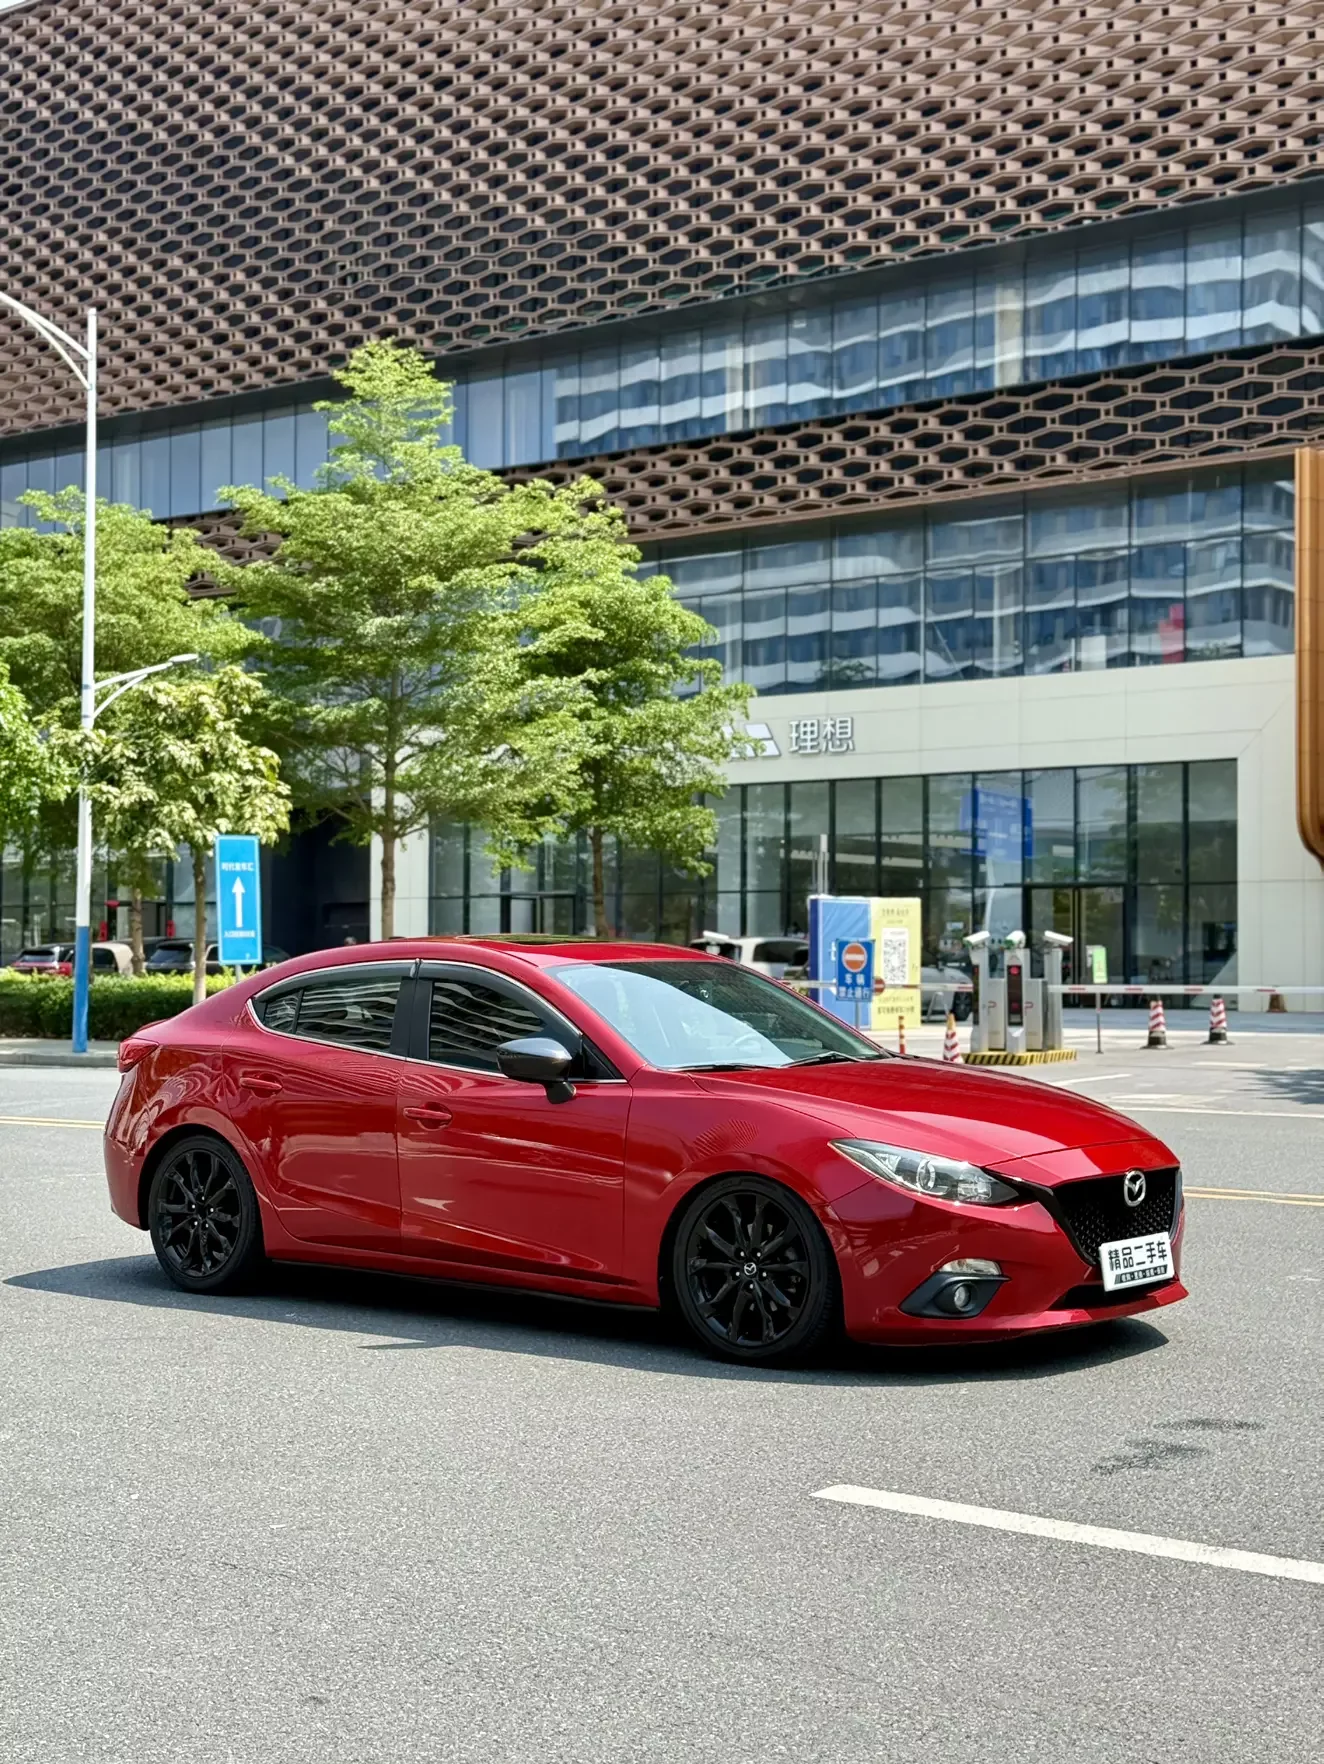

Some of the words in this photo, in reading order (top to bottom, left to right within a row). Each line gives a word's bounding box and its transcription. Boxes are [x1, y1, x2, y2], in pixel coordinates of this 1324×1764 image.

[788, 717, 855, 754] 理想
[1108, 1240, 1168, 1271] 精品二手车
